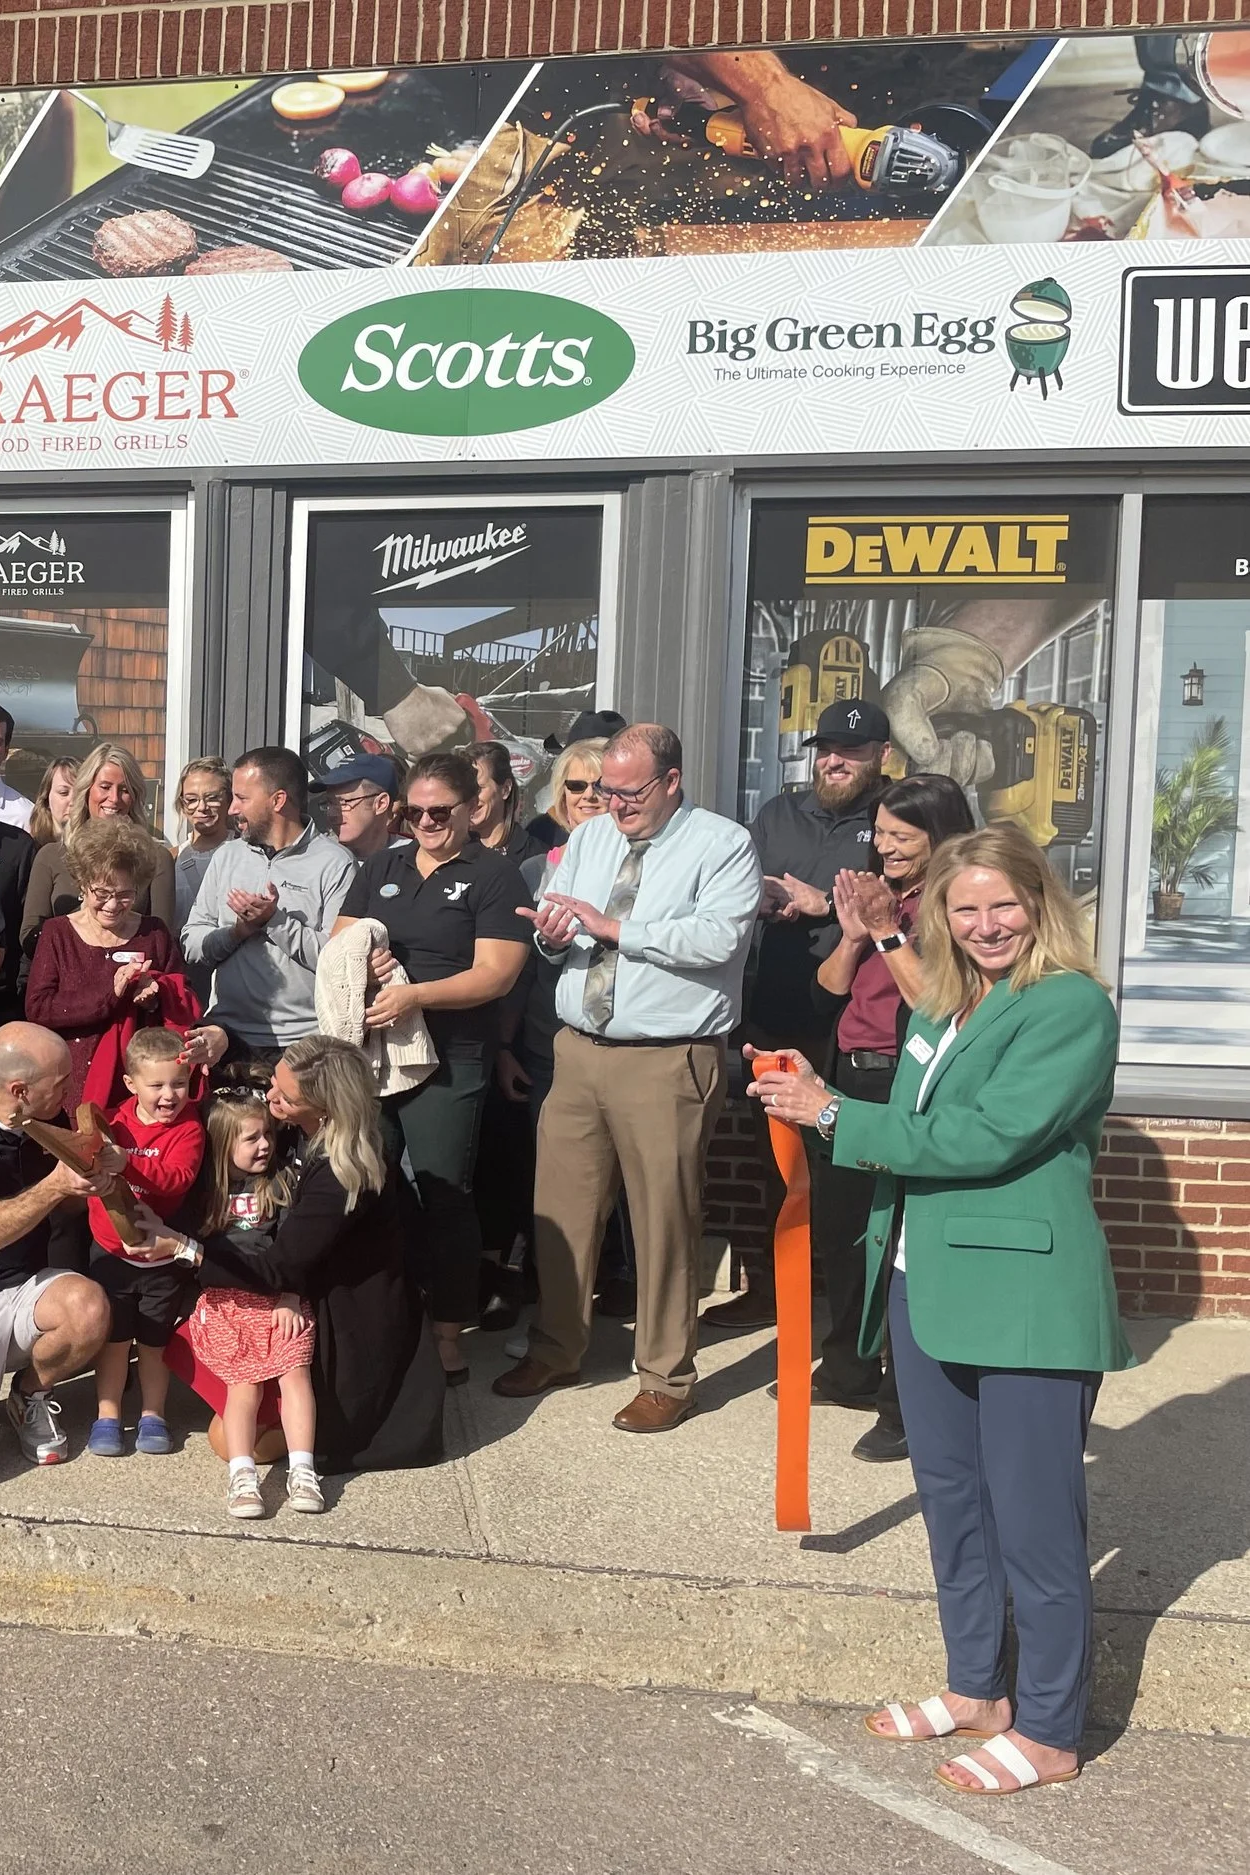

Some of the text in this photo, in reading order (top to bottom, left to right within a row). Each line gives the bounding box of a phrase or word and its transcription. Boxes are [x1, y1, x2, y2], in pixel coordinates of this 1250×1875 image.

[686, 312, 997, 362] Big Green Egg
[340, 322, 594, 393] Scotts
[713, 361, 966, 381] The Ultimate Cooking Experience
[41, 436, 102, 452] FIRED
[113, 434, 189, 451] GRILLS
[372, 522, 527, 580] Milwaukee
[2, 588, 28, 596] FIRED
[32, 587, 65, 596] GRILLS
